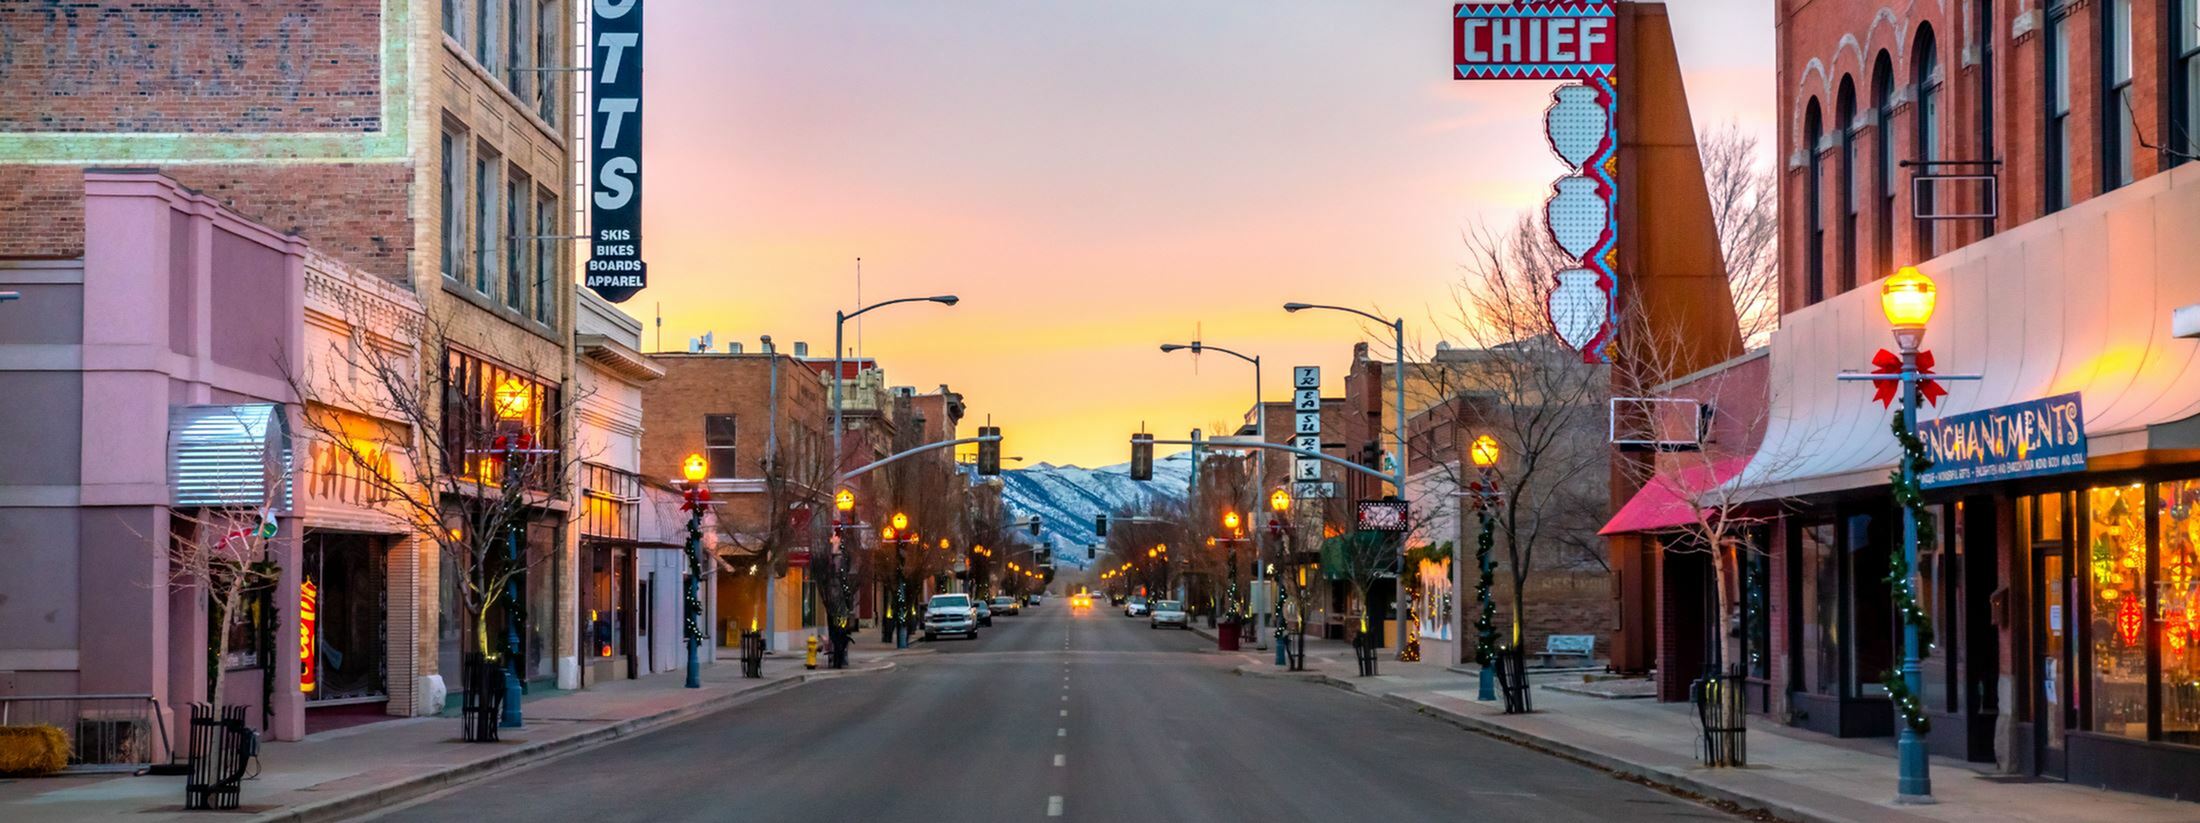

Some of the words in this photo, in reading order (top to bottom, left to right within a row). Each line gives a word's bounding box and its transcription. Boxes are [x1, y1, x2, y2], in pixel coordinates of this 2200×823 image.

[1464, 18, 1608, 62] CHIEF
[601, 229, 631, 240] SKIS
[597, 245, 635, 256] BIKES
[590, 260, 641, 271] BOARDS
[587, 275, 644, 287] APPAREL
[1919, 402, 2079, 464] ENCHANTMENTS
